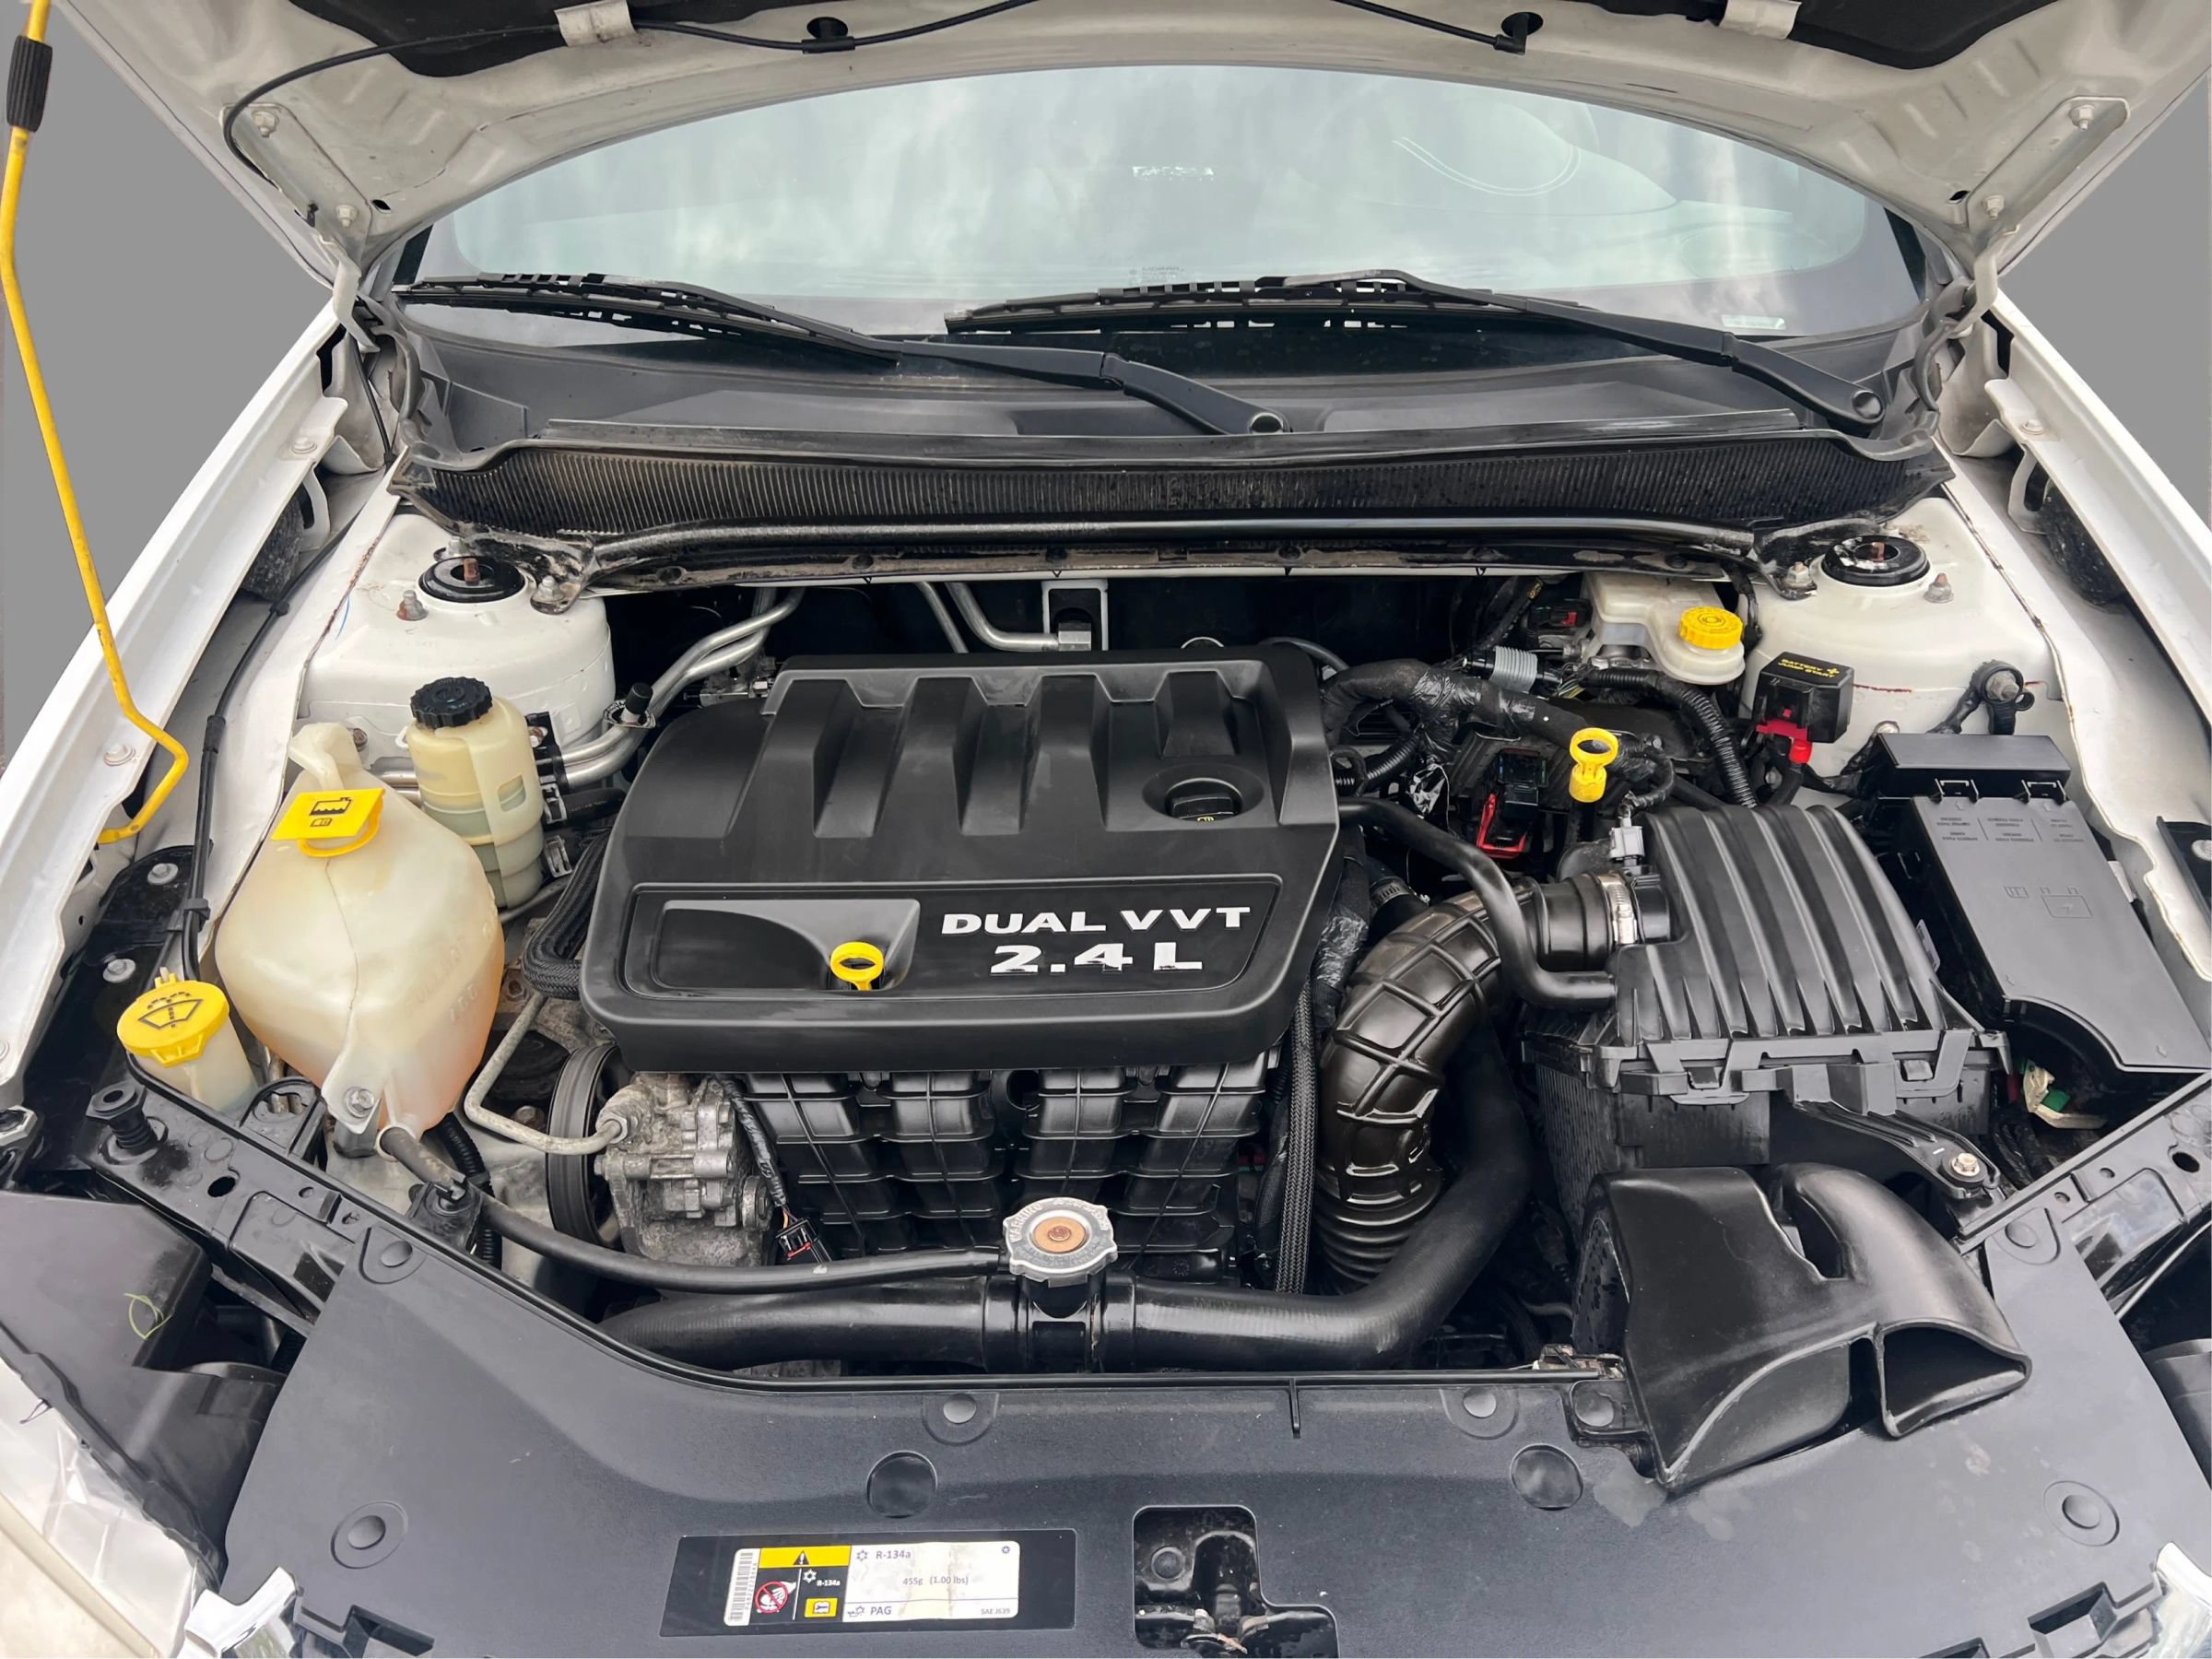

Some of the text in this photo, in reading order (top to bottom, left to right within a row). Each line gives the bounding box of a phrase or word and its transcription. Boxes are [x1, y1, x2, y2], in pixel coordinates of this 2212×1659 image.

[942, 907, 1251, 935] DUAL VVT
[876, 1550, 912, 1559] R-134a
[902, 1577, 924, 1586] 455g
[870, 1606, 892, 1616] PAG
